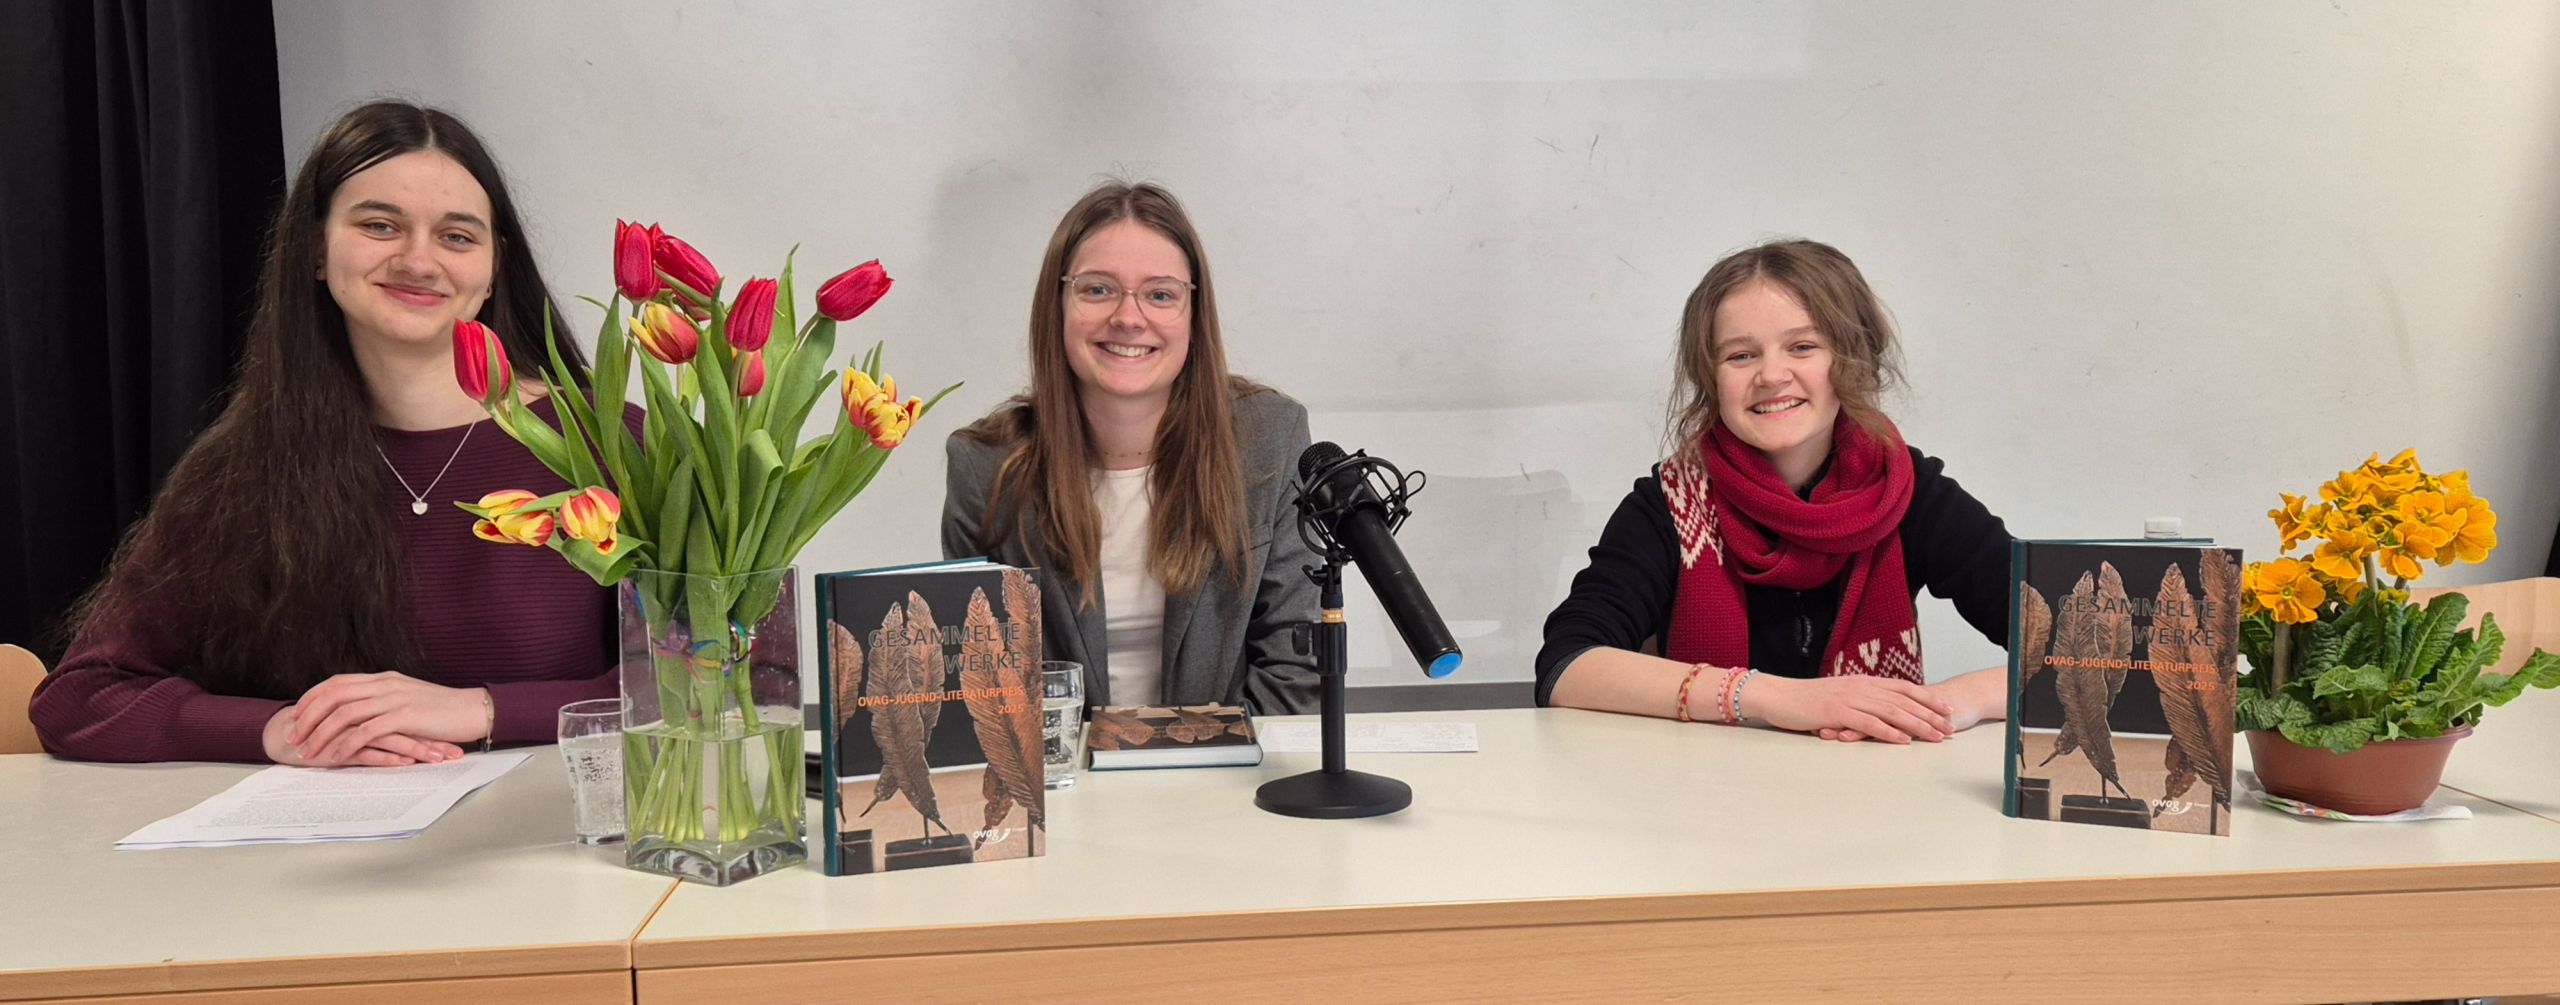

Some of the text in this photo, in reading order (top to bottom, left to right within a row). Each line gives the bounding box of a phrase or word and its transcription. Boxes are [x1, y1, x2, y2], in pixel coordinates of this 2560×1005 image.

[2058, 594, 2217, 619] GESAMMELTE
[868, 622, 1020, 648] GESAMMELTE
[2132, 625, 2216, 647] WERKE
[944, 651, 1022, 675] WERKE
[2044, 655, 2217, 674] OVAG-JUGEND-LITERATURPREIS
[2186, 680, 2215, 691] 2025
[858, 686, 1025, 707] OVAG-JUGEND-LITERATURPREIS
[998, 703, 1024, 715] 2025
